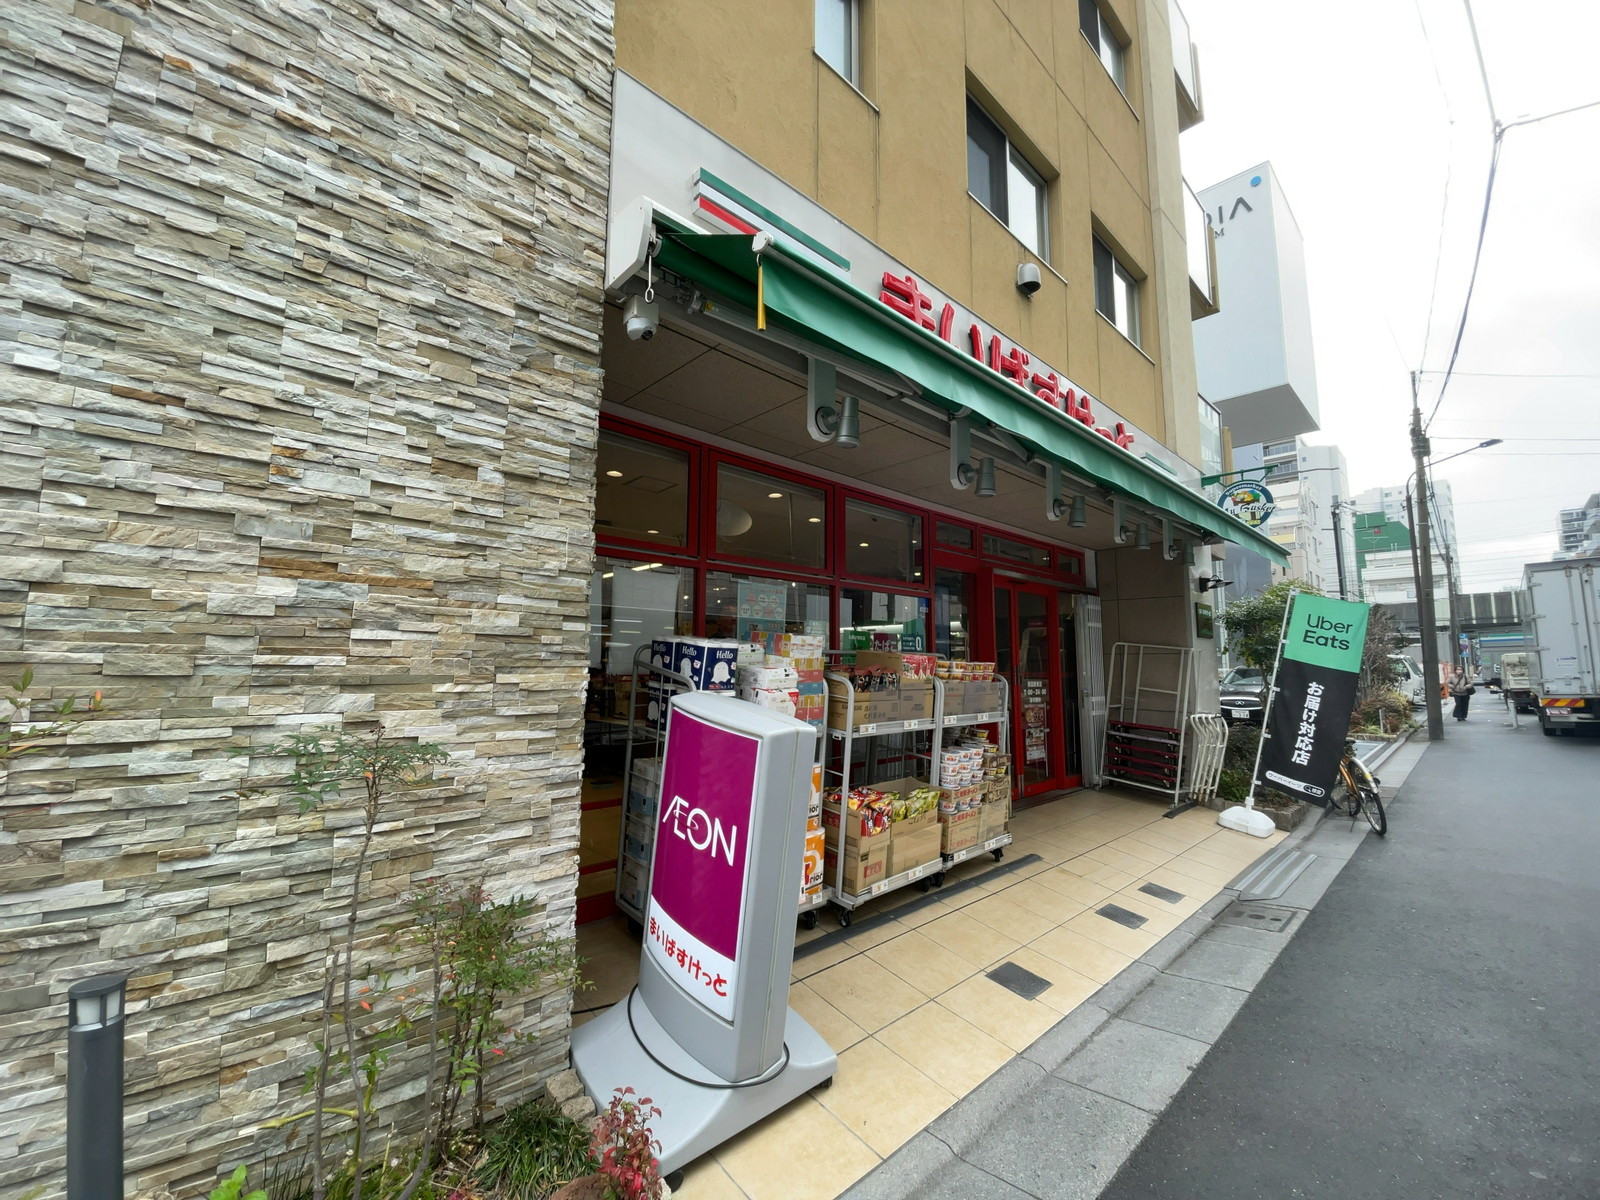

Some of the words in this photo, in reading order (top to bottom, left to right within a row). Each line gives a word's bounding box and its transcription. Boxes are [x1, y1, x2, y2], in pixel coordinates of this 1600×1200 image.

[1225, 483, 1262, 496] Supermarket
[1240, 502, 1277, 513] Basket
[1306, 613, 1353, 636] Uber
[1302, 630, 1350, 652] Eats
[682, 645, 698, 657] Hello
[716, 650, 734, 659] Hello
[1291, 681, 1325, 766] お届け対応店
[649, 917, 729, 997] まいばすけっと
